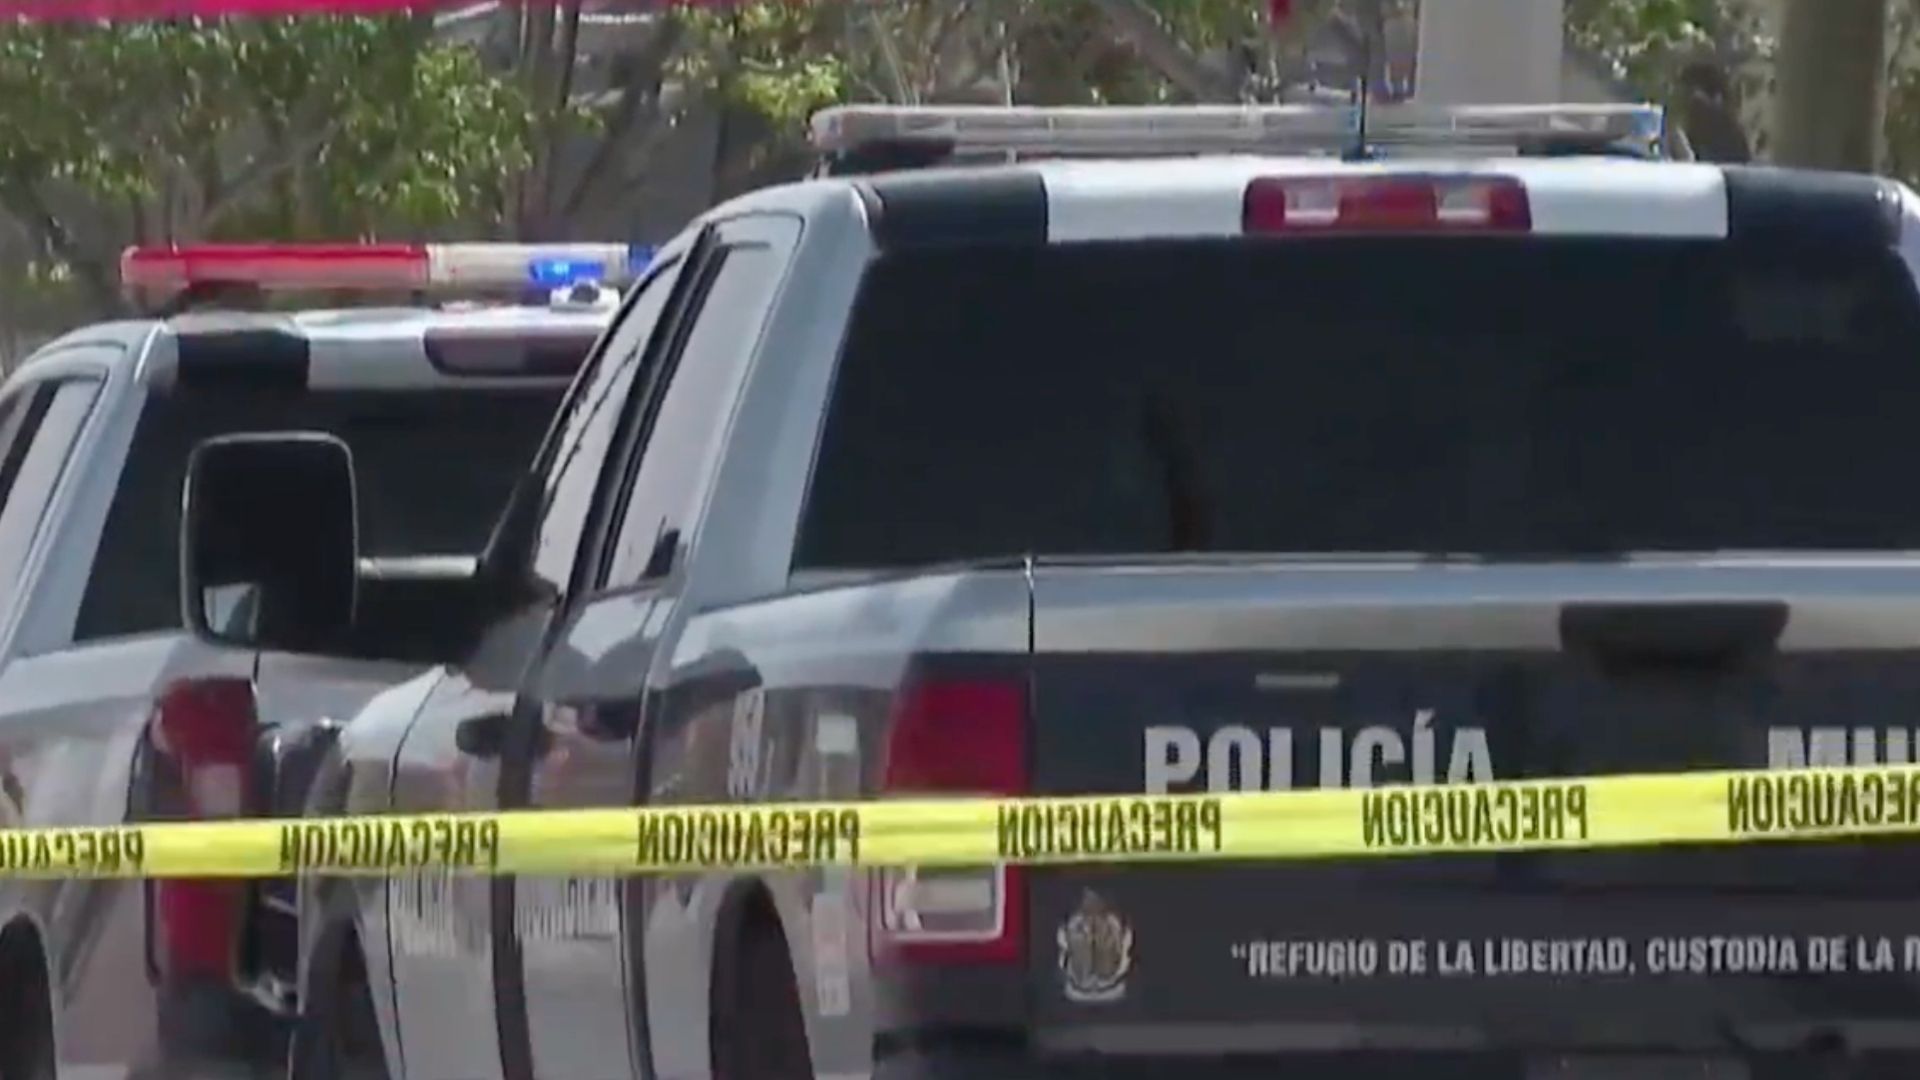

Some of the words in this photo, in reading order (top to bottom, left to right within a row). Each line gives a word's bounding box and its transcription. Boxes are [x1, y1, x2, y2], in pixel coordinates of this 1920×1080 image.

[1388, 939, 1427, 974] DE
[1438, 939, 1475, 974] LA
[1484, 937, 1635, 976] LIBERTAD,
[1647, 935, 1799, 973] CUSTODIA
[1807, 935, 1847, 972] DE
[1857, 935, 1895, 972] LA
